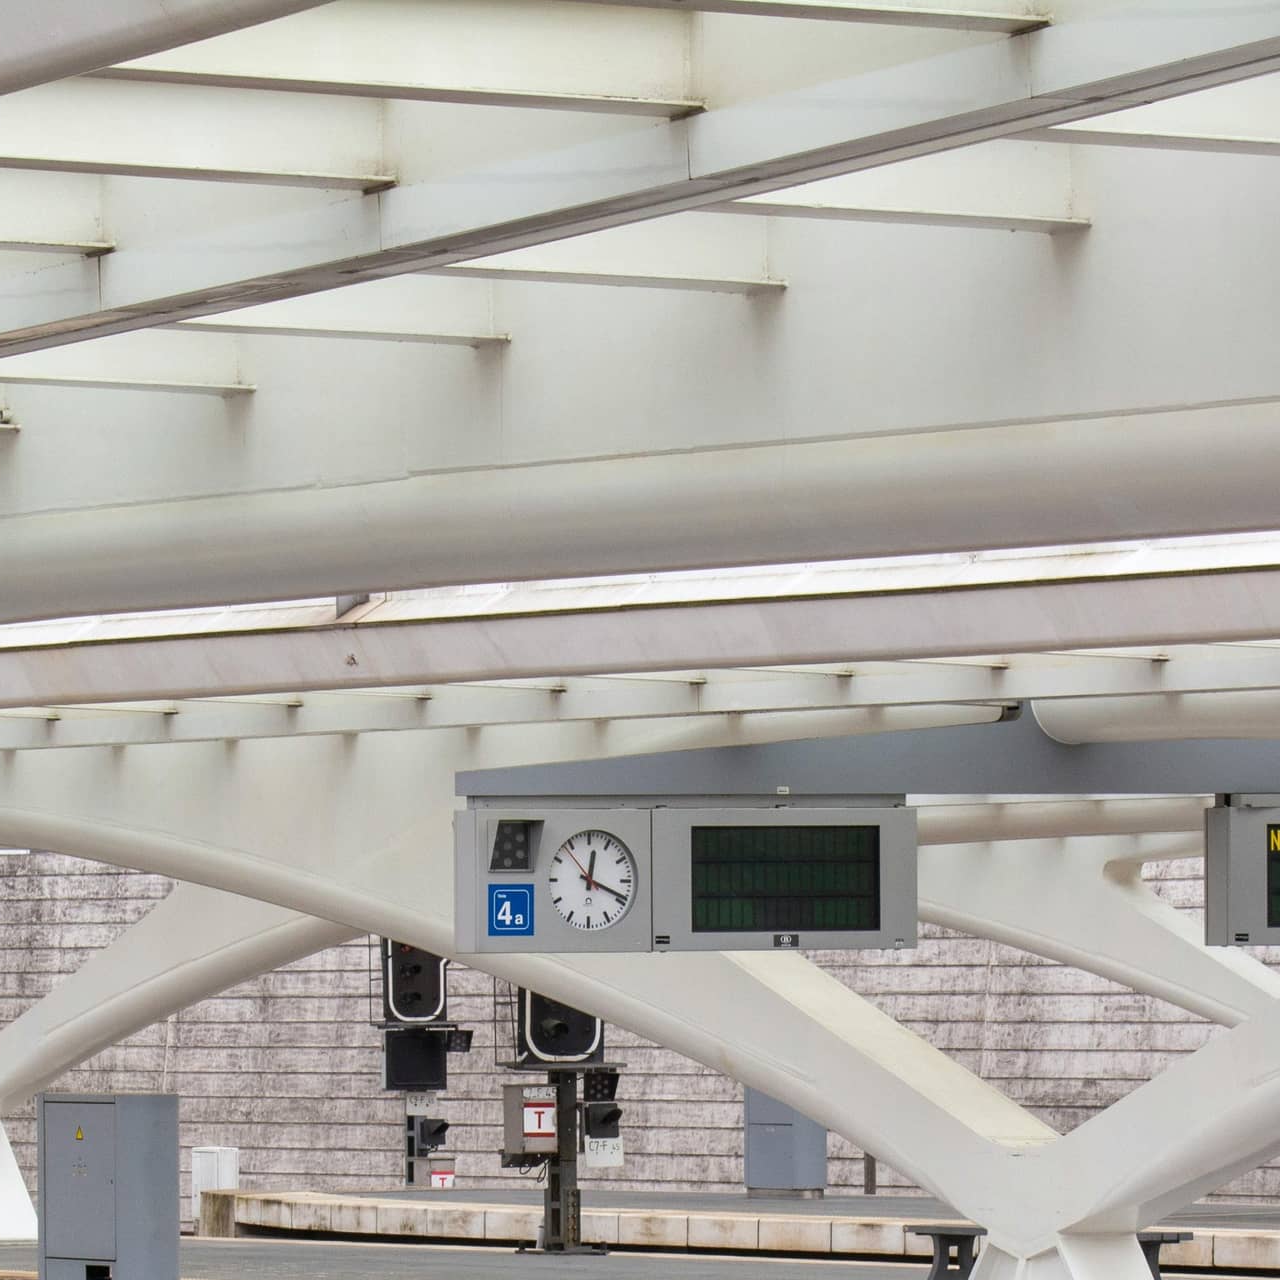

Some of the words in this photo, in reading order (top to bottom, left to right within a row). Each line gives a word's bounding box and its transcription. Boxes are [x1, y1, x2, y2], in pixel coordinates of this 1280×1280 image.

[497, 901, 524, 925] 4a
[534, 1110, 545, 1129] T
[439, 1177, 447, 1189] T
